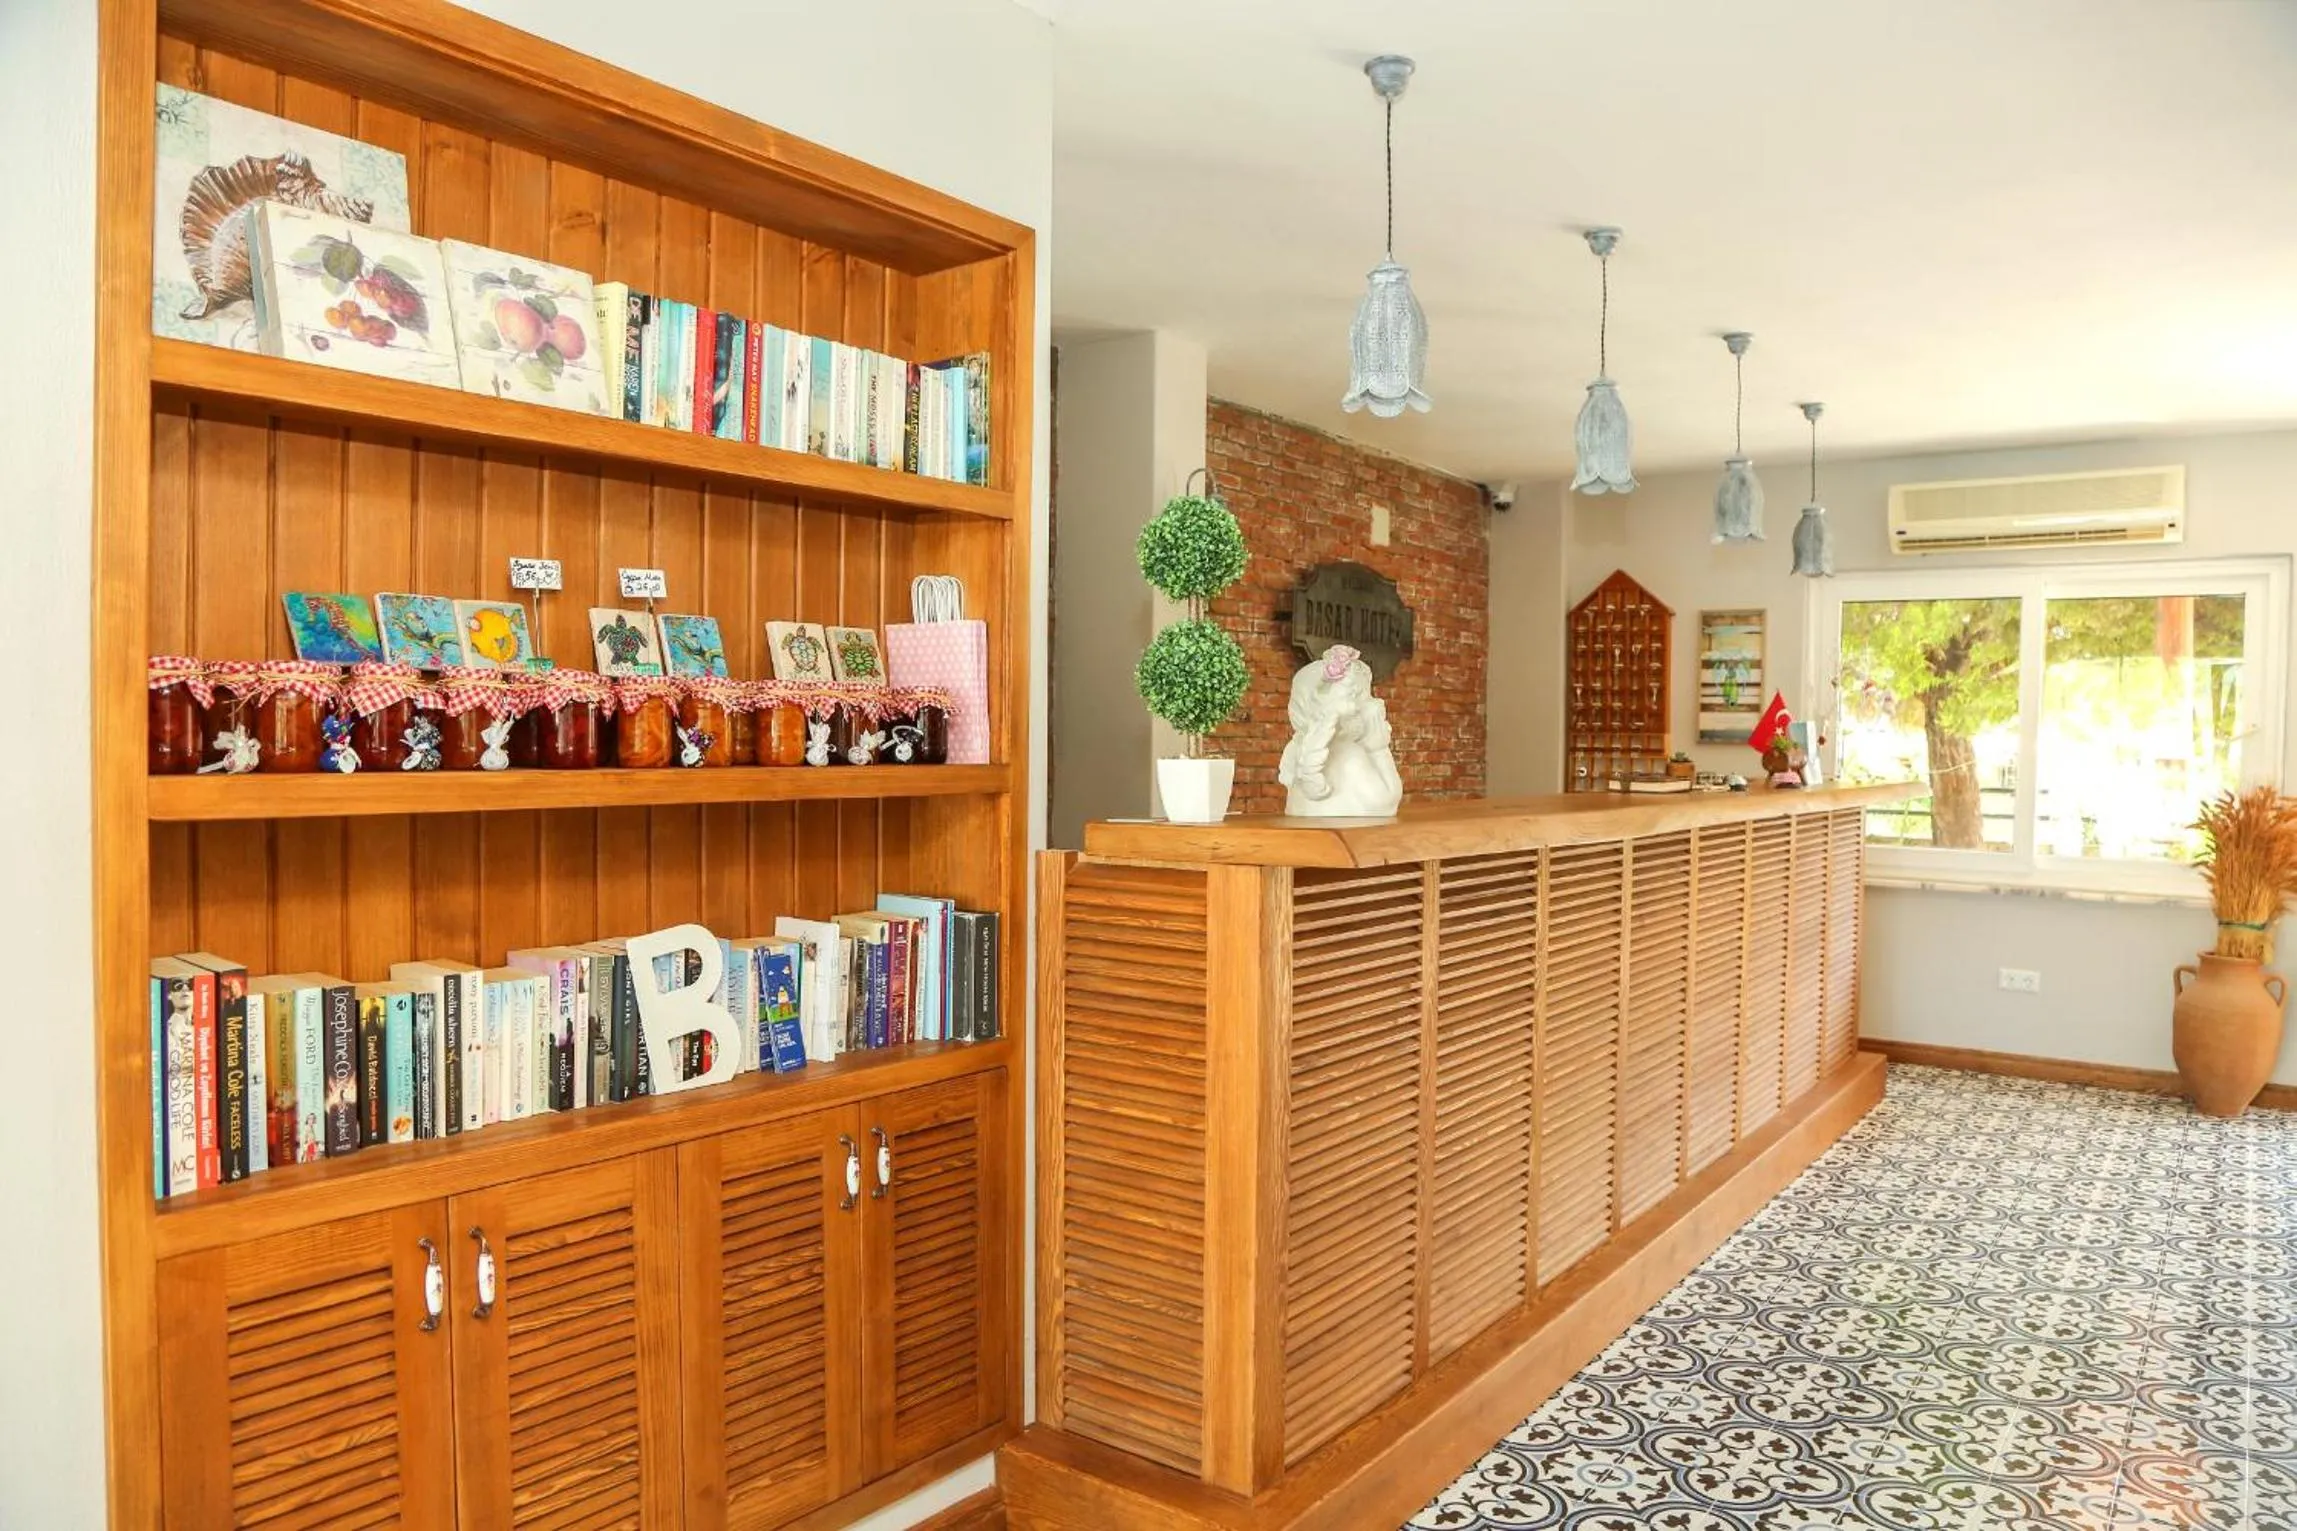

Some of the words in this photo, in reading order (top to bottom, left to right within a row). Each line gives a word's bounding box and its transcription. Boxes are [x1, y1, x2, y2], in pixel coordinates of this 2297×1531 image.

[751, 336, 759, 363] PETER
[560, 968, 569, 1016] CRAIS
[626, 922, 742, 1096] B
[226, 1016, 244, 1068] Martina
[305, 1028, 316, 1065] FORD
[331, 991, 353, 1060] Josephine
[367, 1035, 378, 1060] David
[181, 1031, 194, 1098] MARTINA
[637, 1023, 648, 1076] RTIAN
[227, 1069, 245, 1098] Cole
[367, 1060, 378, 1100] Baldacci
[170, 1102, 181, 1129] LIFE
[182, 1101, 195, 1142] COLE
[230, 1101, 242, 1150] FACELESS
